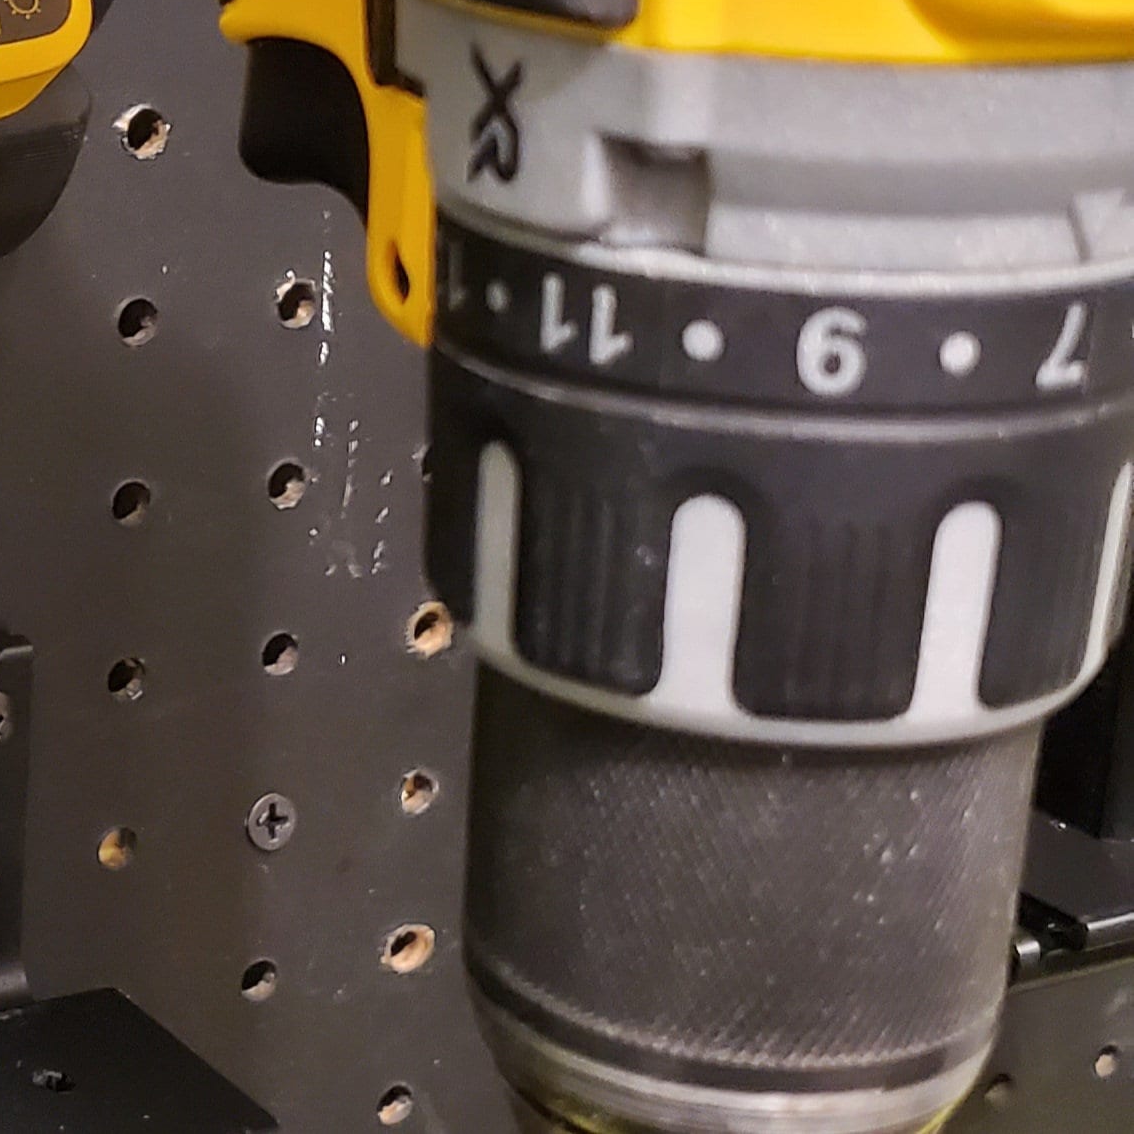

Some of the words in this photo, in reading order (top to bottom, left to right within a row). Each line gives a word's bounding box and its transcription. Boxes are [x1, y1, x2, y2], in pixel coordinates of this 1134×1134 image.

[468, 40, 523, 183] XR
[539, 272, 636, 366] 11
[1034, 300, 1088, 392] 7
